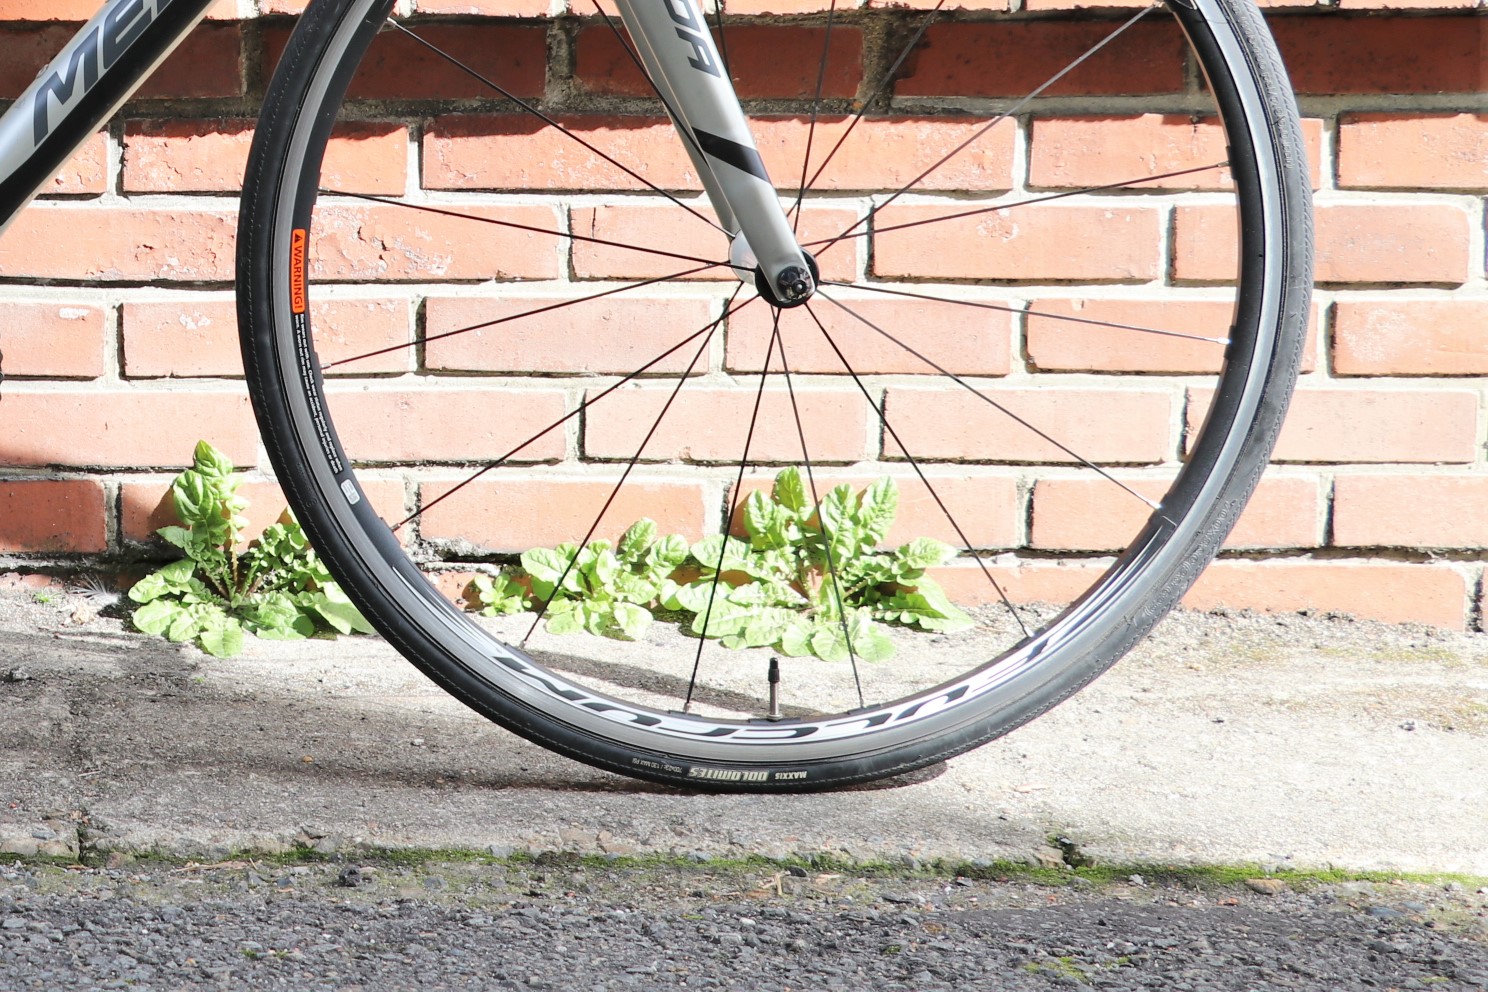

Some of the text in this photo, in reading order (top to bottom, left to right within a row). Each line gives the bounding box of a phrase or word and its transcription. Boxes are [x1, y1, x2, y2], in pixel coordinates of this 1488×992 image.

[294, 246, 303, 309] WARNING!
[493, 637, 1054, 740] FULCRUM
[687, 766, 770, 782] DOLOMITES
[774, 771, 808, 781] MAXXIS
